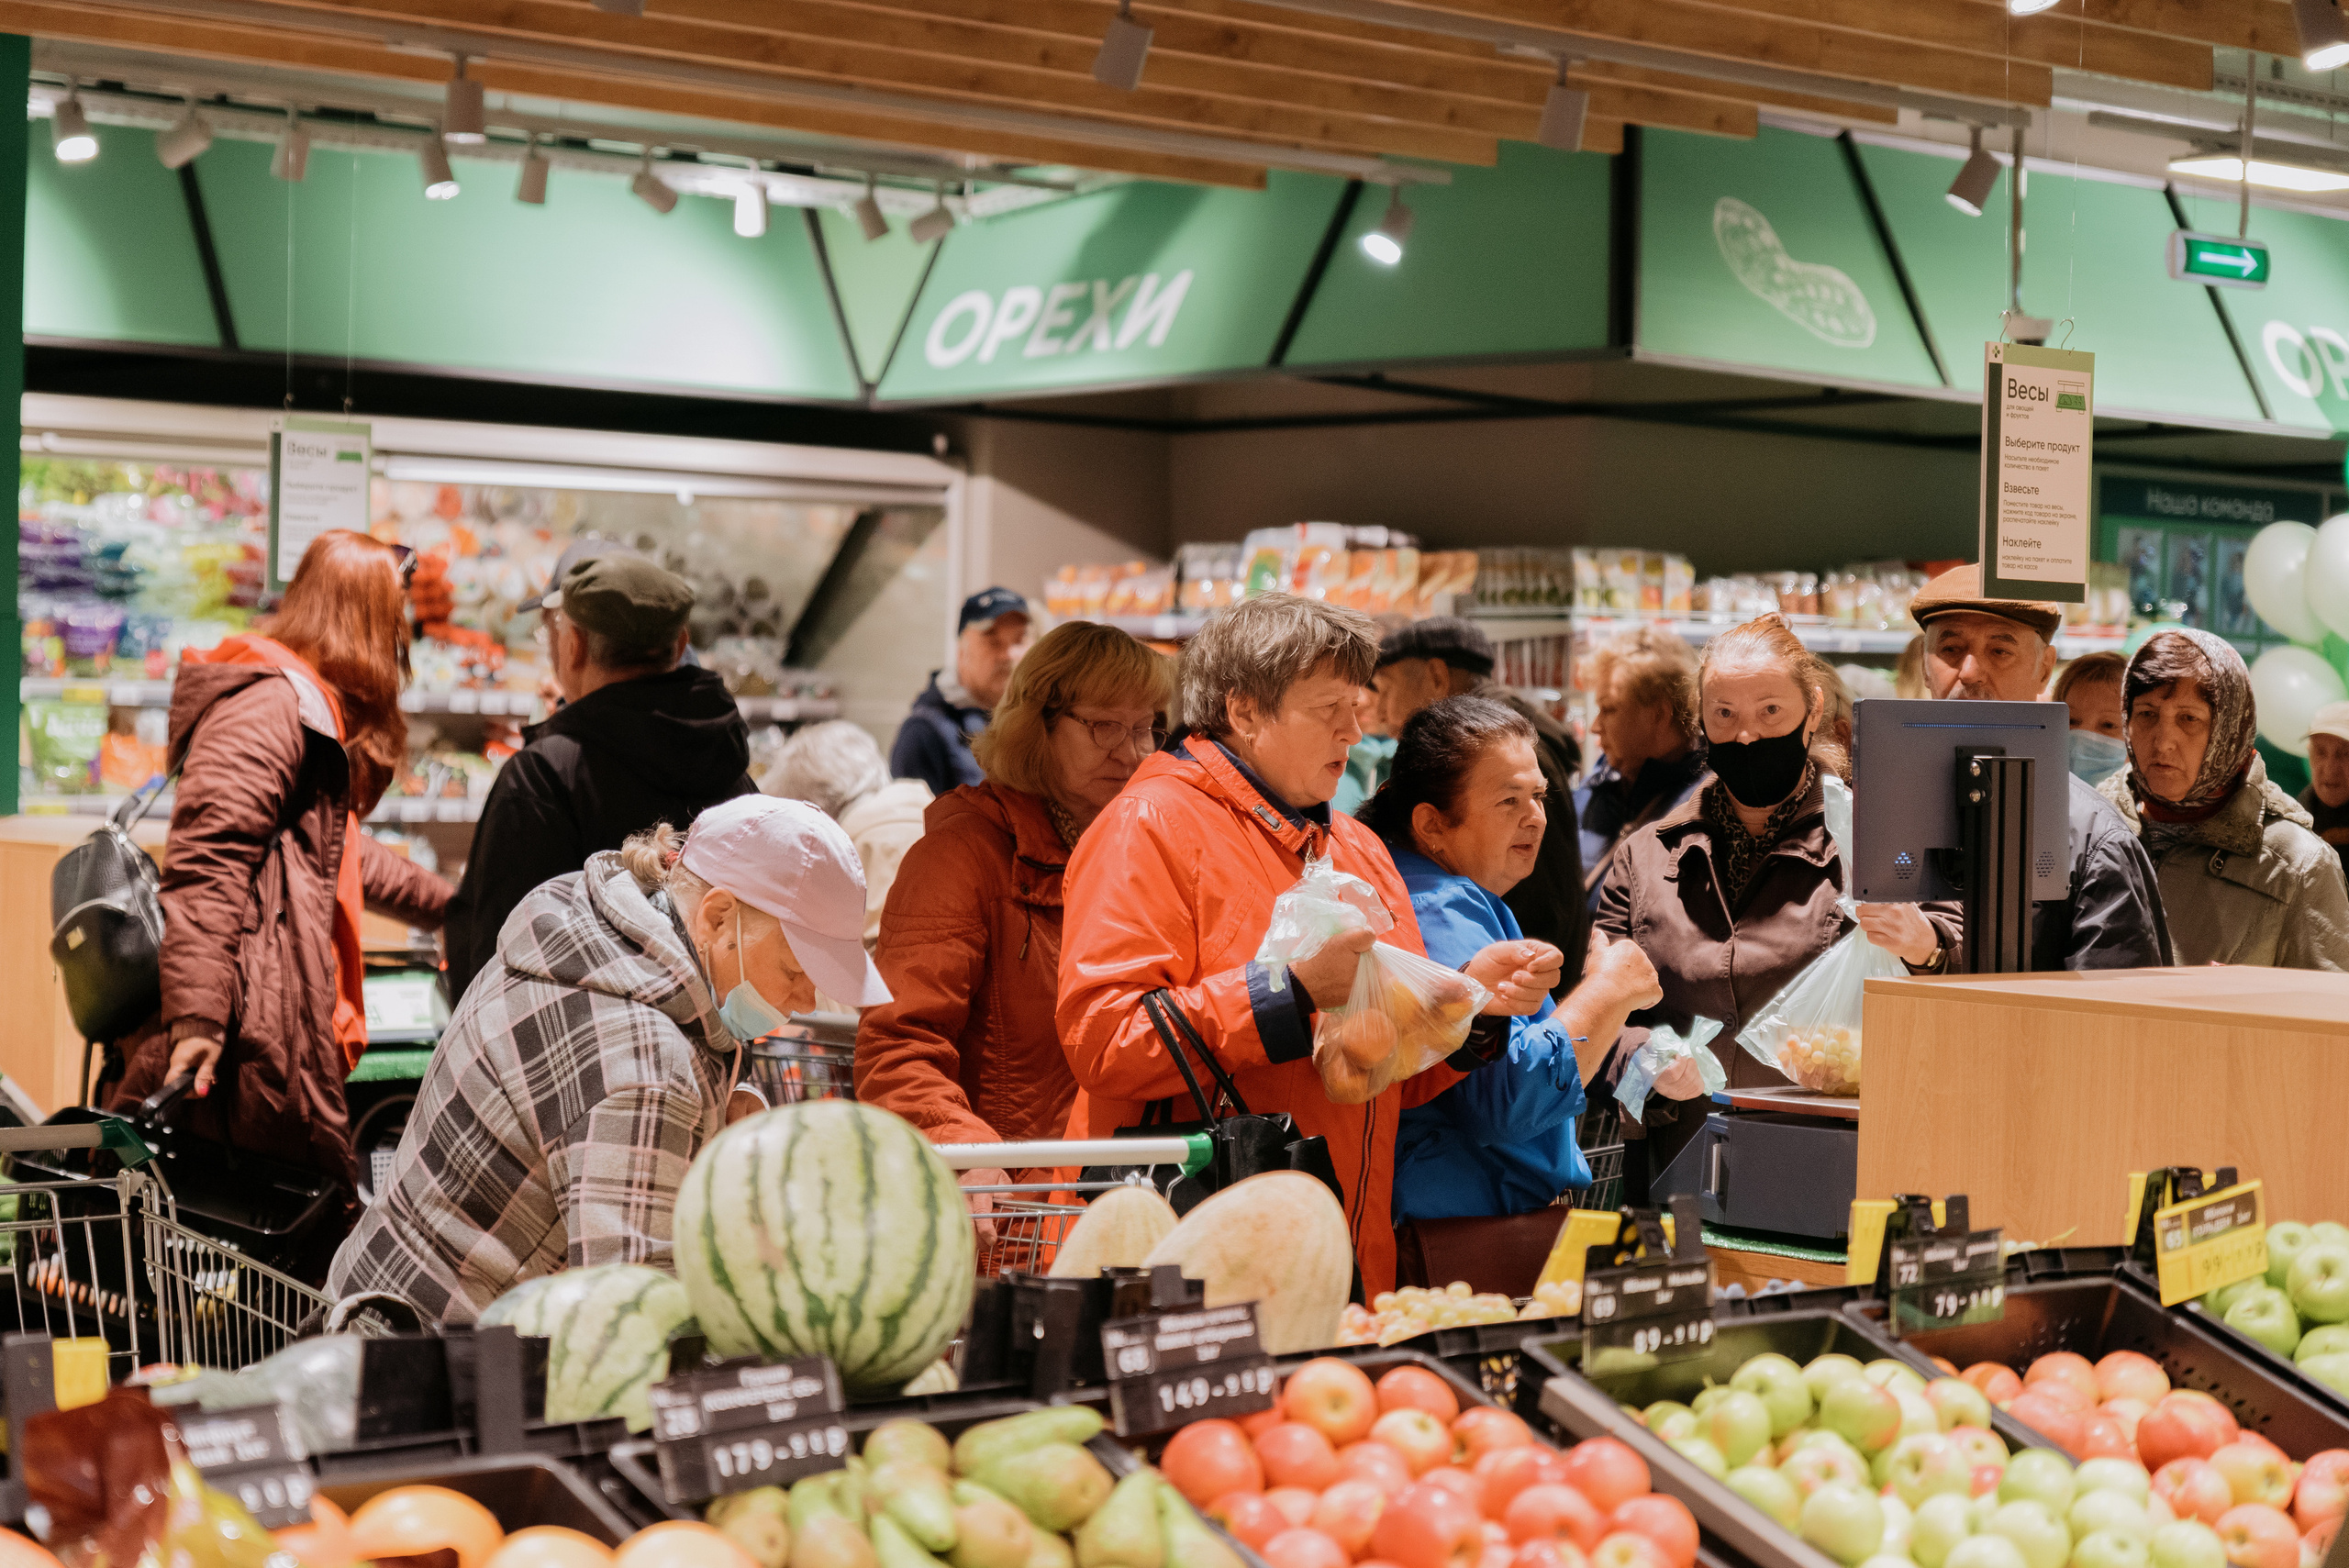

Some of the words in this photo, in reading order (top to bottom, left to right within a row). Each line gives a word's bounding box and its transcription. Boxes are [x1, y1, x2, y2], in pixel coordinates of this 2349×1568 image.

[924, 270, 1194, 369] ОРЕХИ
[2008, 378, 2049, 402] Весы
[286, 439, 327, 458] Весы
[2005, 436, 2045, 450] Выберите
[2047, 442, 2080, 454] продукт
[2028, 457, 2060, 465] необходимое
[2004, 482, 2040, 495] Взвесьте
[2147, 487, 2198, 515] Наша
[2201, 496, 2274, 522] команда
[2003, 517, 2037, 525] распечатайте
[2038, 519, 2060, 528] наклейку
[2002, 536, 2042, 549] Наклейте
[1898, 1262, 1919, 1284] 72
